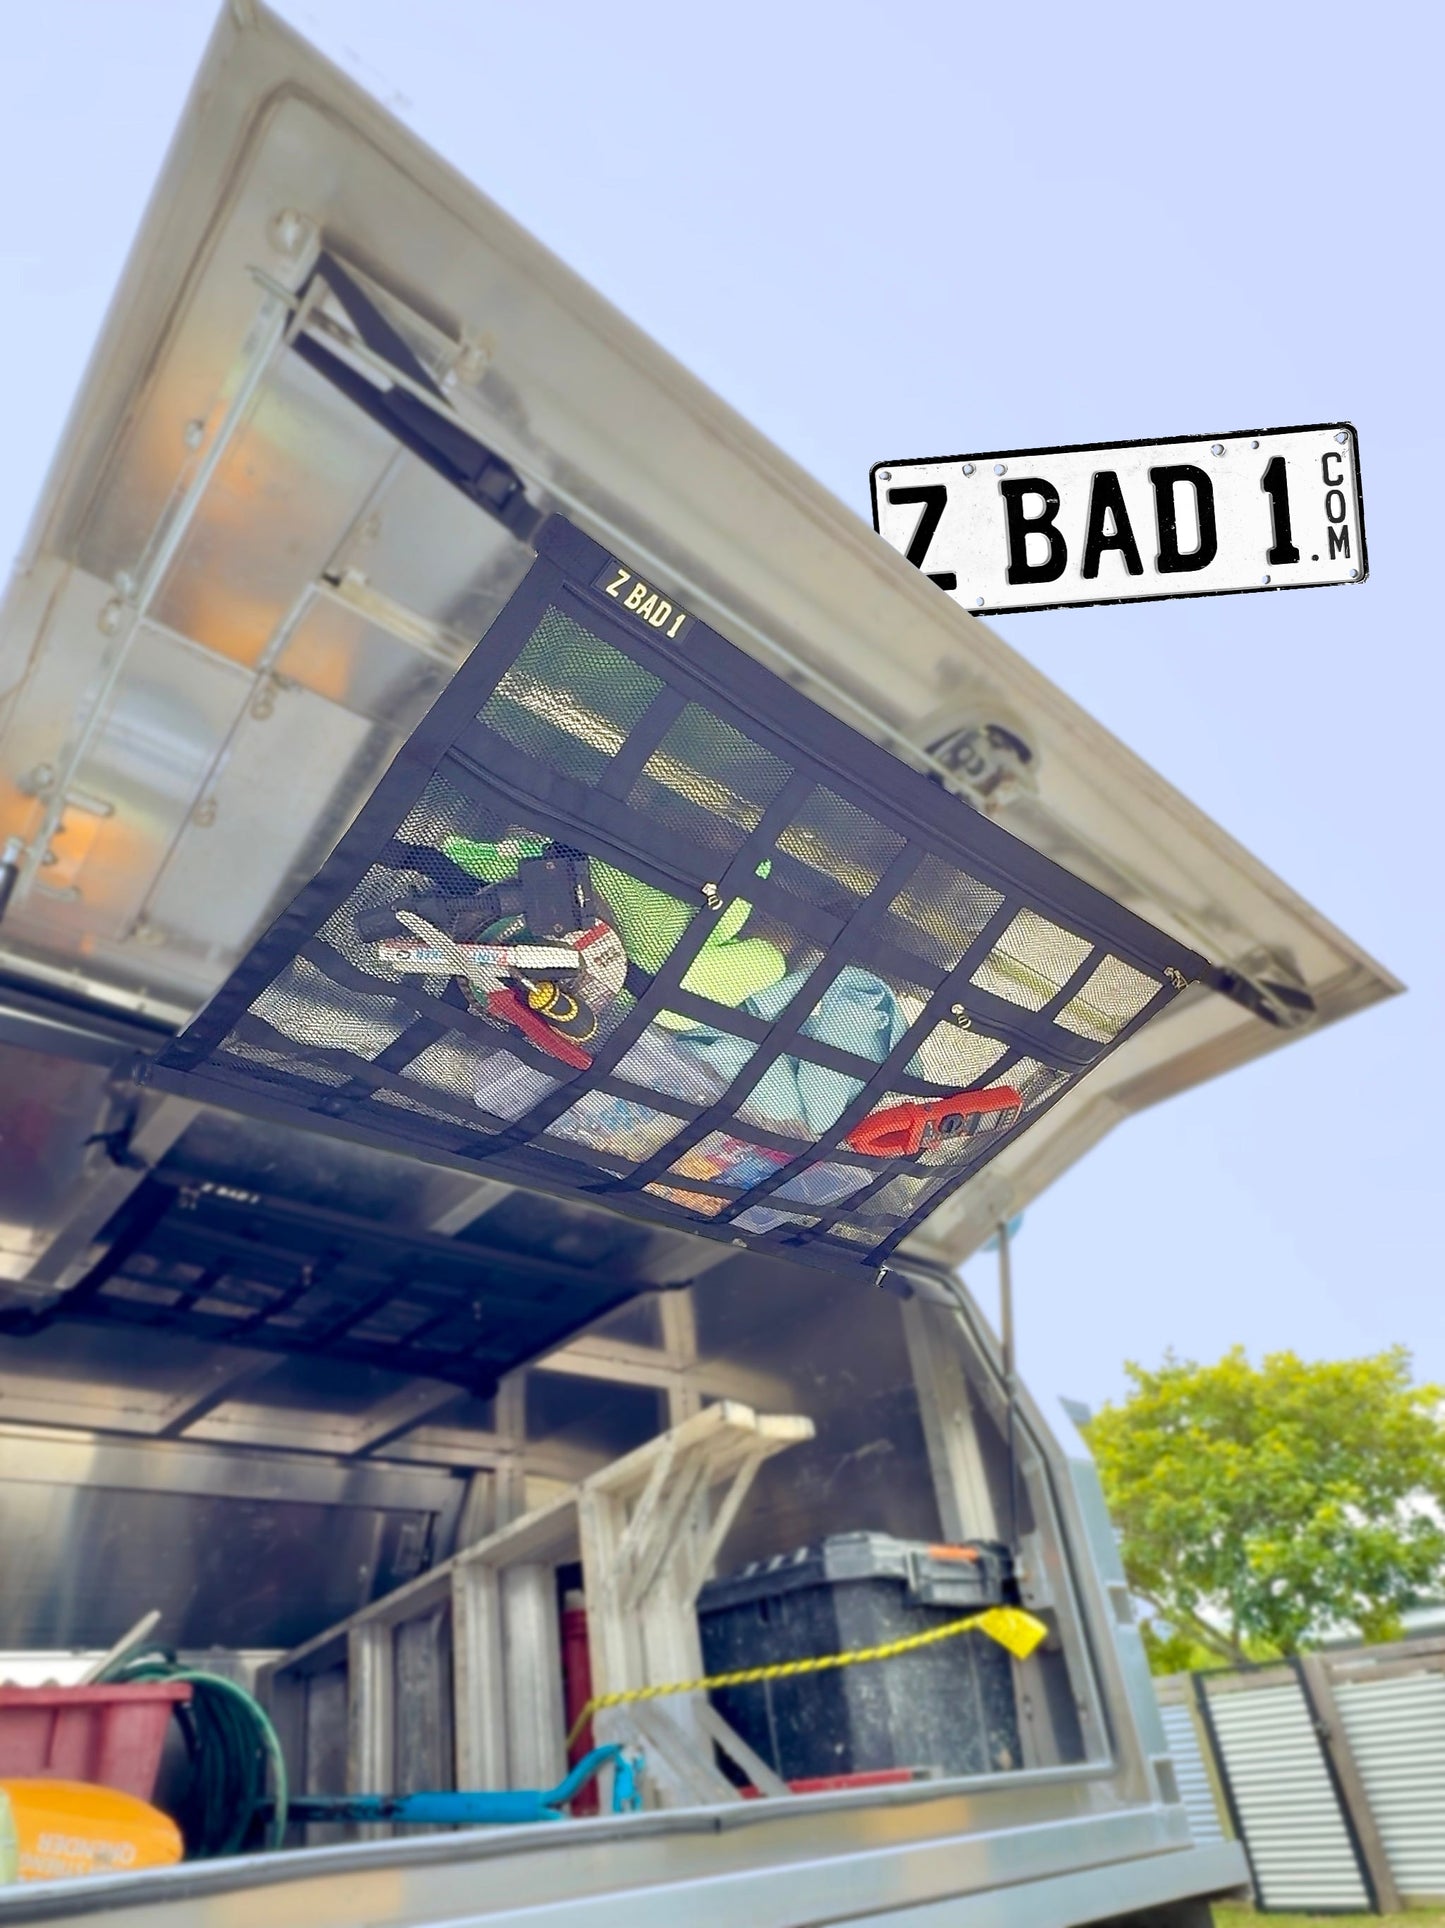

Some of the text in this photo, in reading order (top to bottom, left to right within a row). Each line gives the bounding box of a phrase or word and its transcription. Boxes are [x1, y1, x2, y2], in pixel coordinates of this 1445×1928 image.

[605, 568, 687, 638] Z BAD 1
